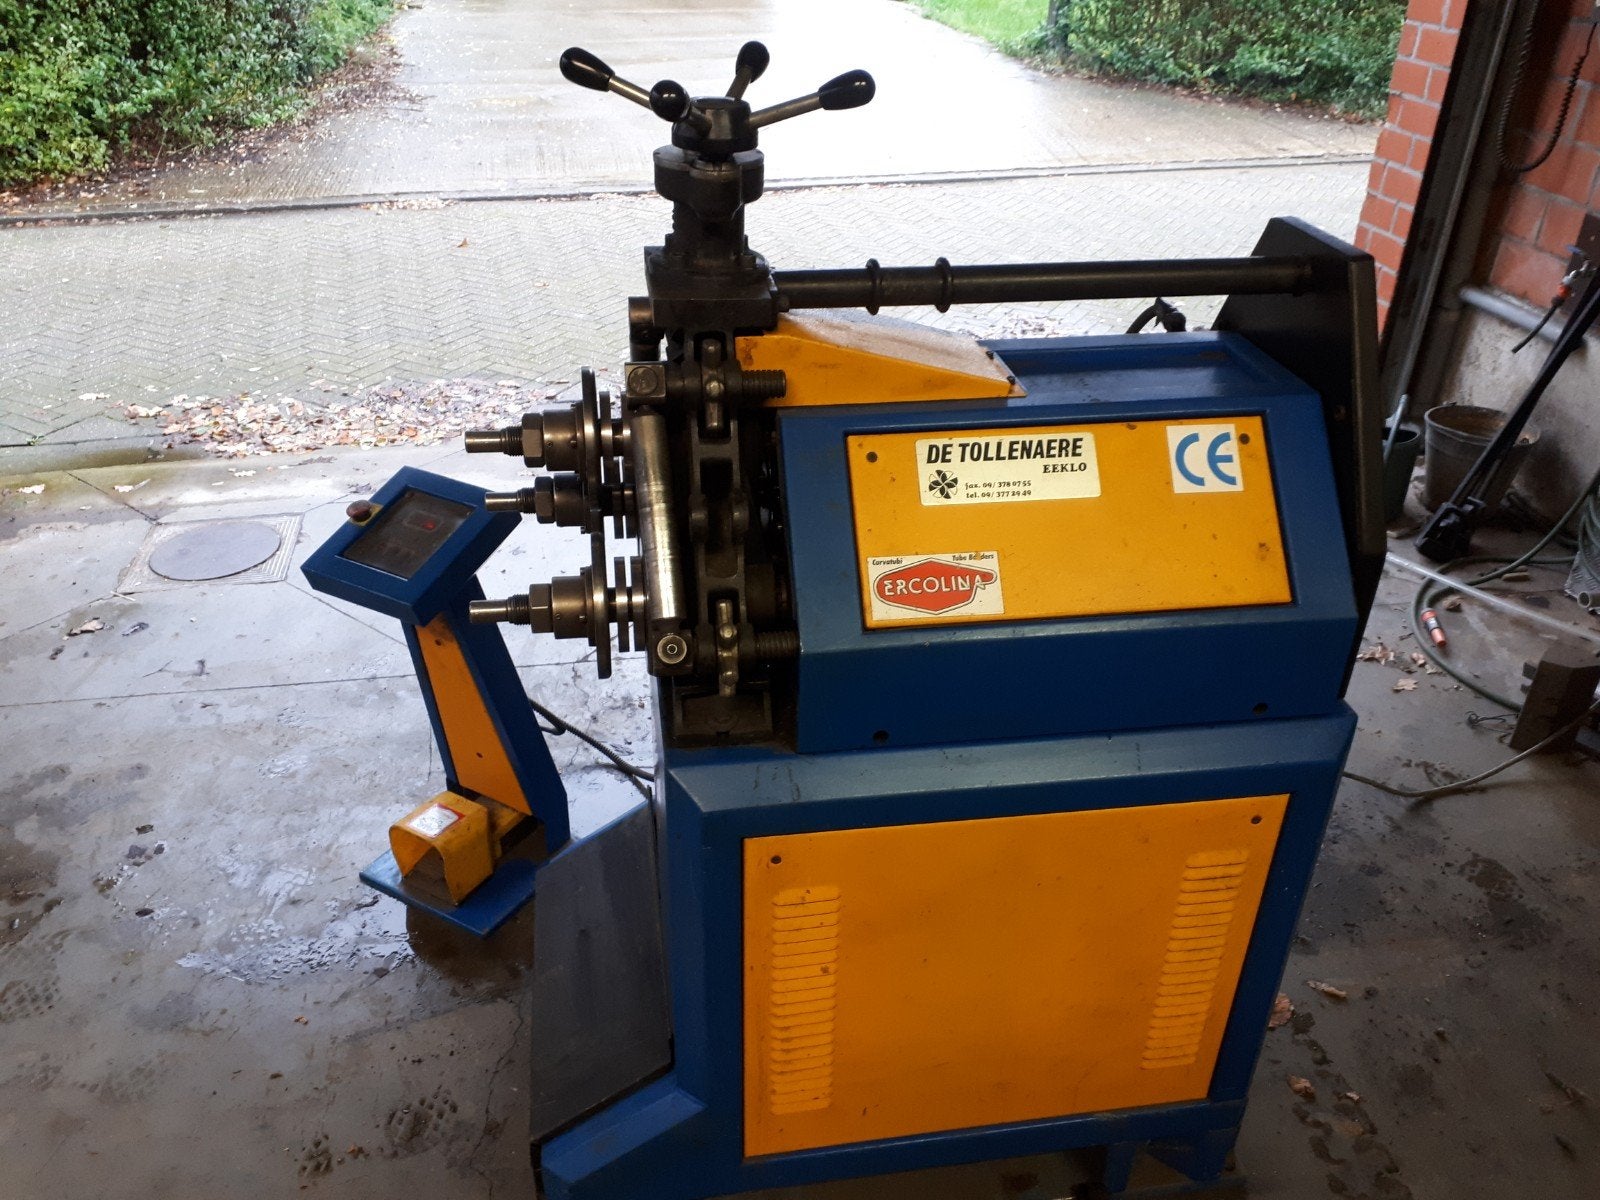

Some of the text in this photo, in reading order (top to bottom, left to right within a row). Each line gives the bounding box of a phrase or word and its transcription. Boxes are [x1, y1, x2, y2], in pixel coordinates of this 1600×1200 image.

[926, 437, 1084, 464] DE TOLLENAERE
[1175, 431, 1237, 487] CE
[1042, 462, 1088, 474] EEKLO
[966, 491, 980, 499] tel.
[883, 574, 986, 596] ERCOLINA
